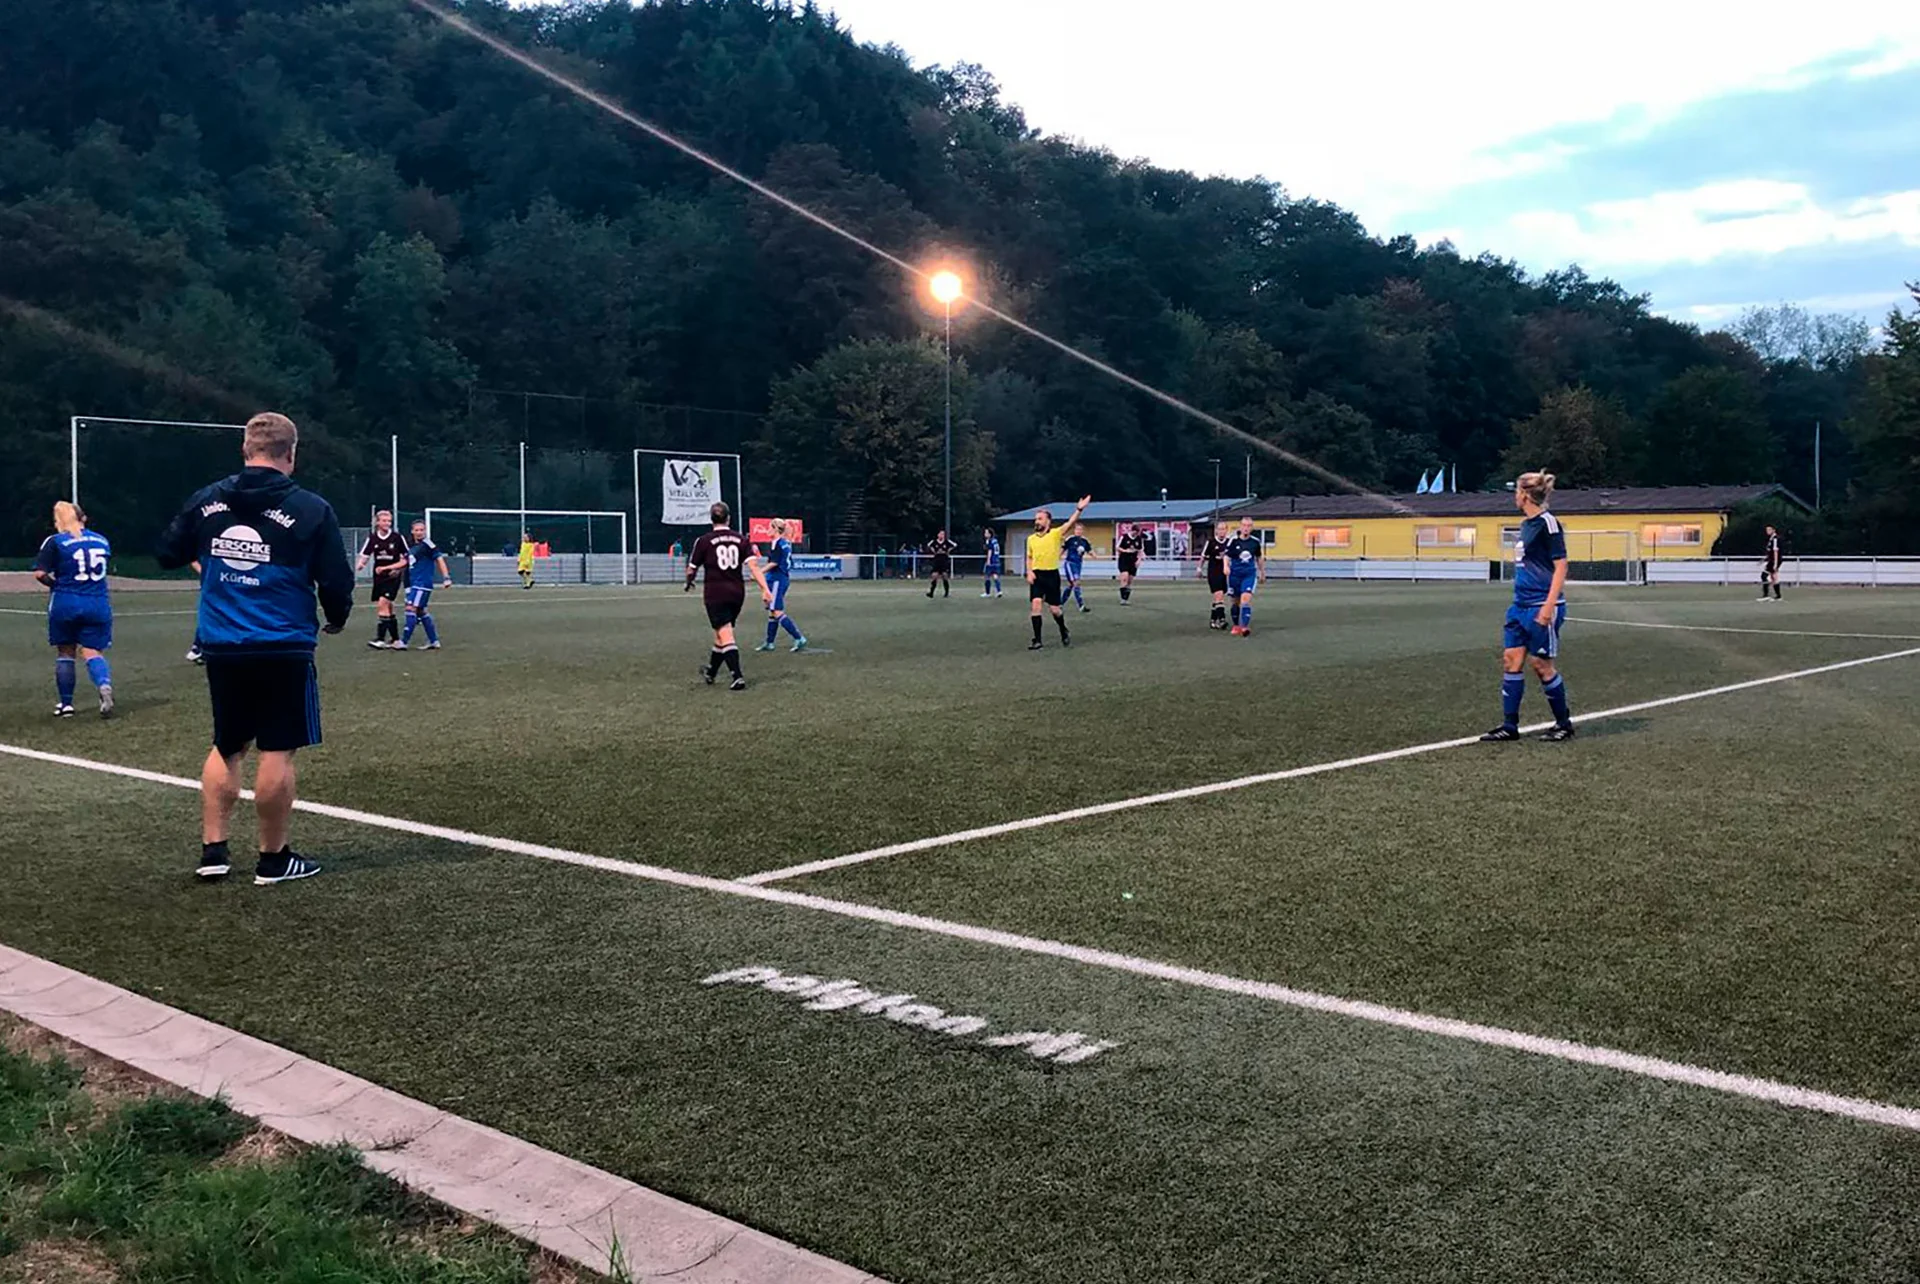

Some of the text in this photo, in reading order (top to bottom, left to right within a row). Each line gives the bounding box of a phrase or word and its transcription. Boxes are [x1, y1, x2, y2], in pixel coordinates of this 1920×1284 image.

[260, 507, 297, 529] esfeld
[211, 537, 271, 555] PERSCHKE
[716, 544, 739, 570] 80
[73, 548, 107, 581] 15
[219, 571, 260, 587] Kürten
